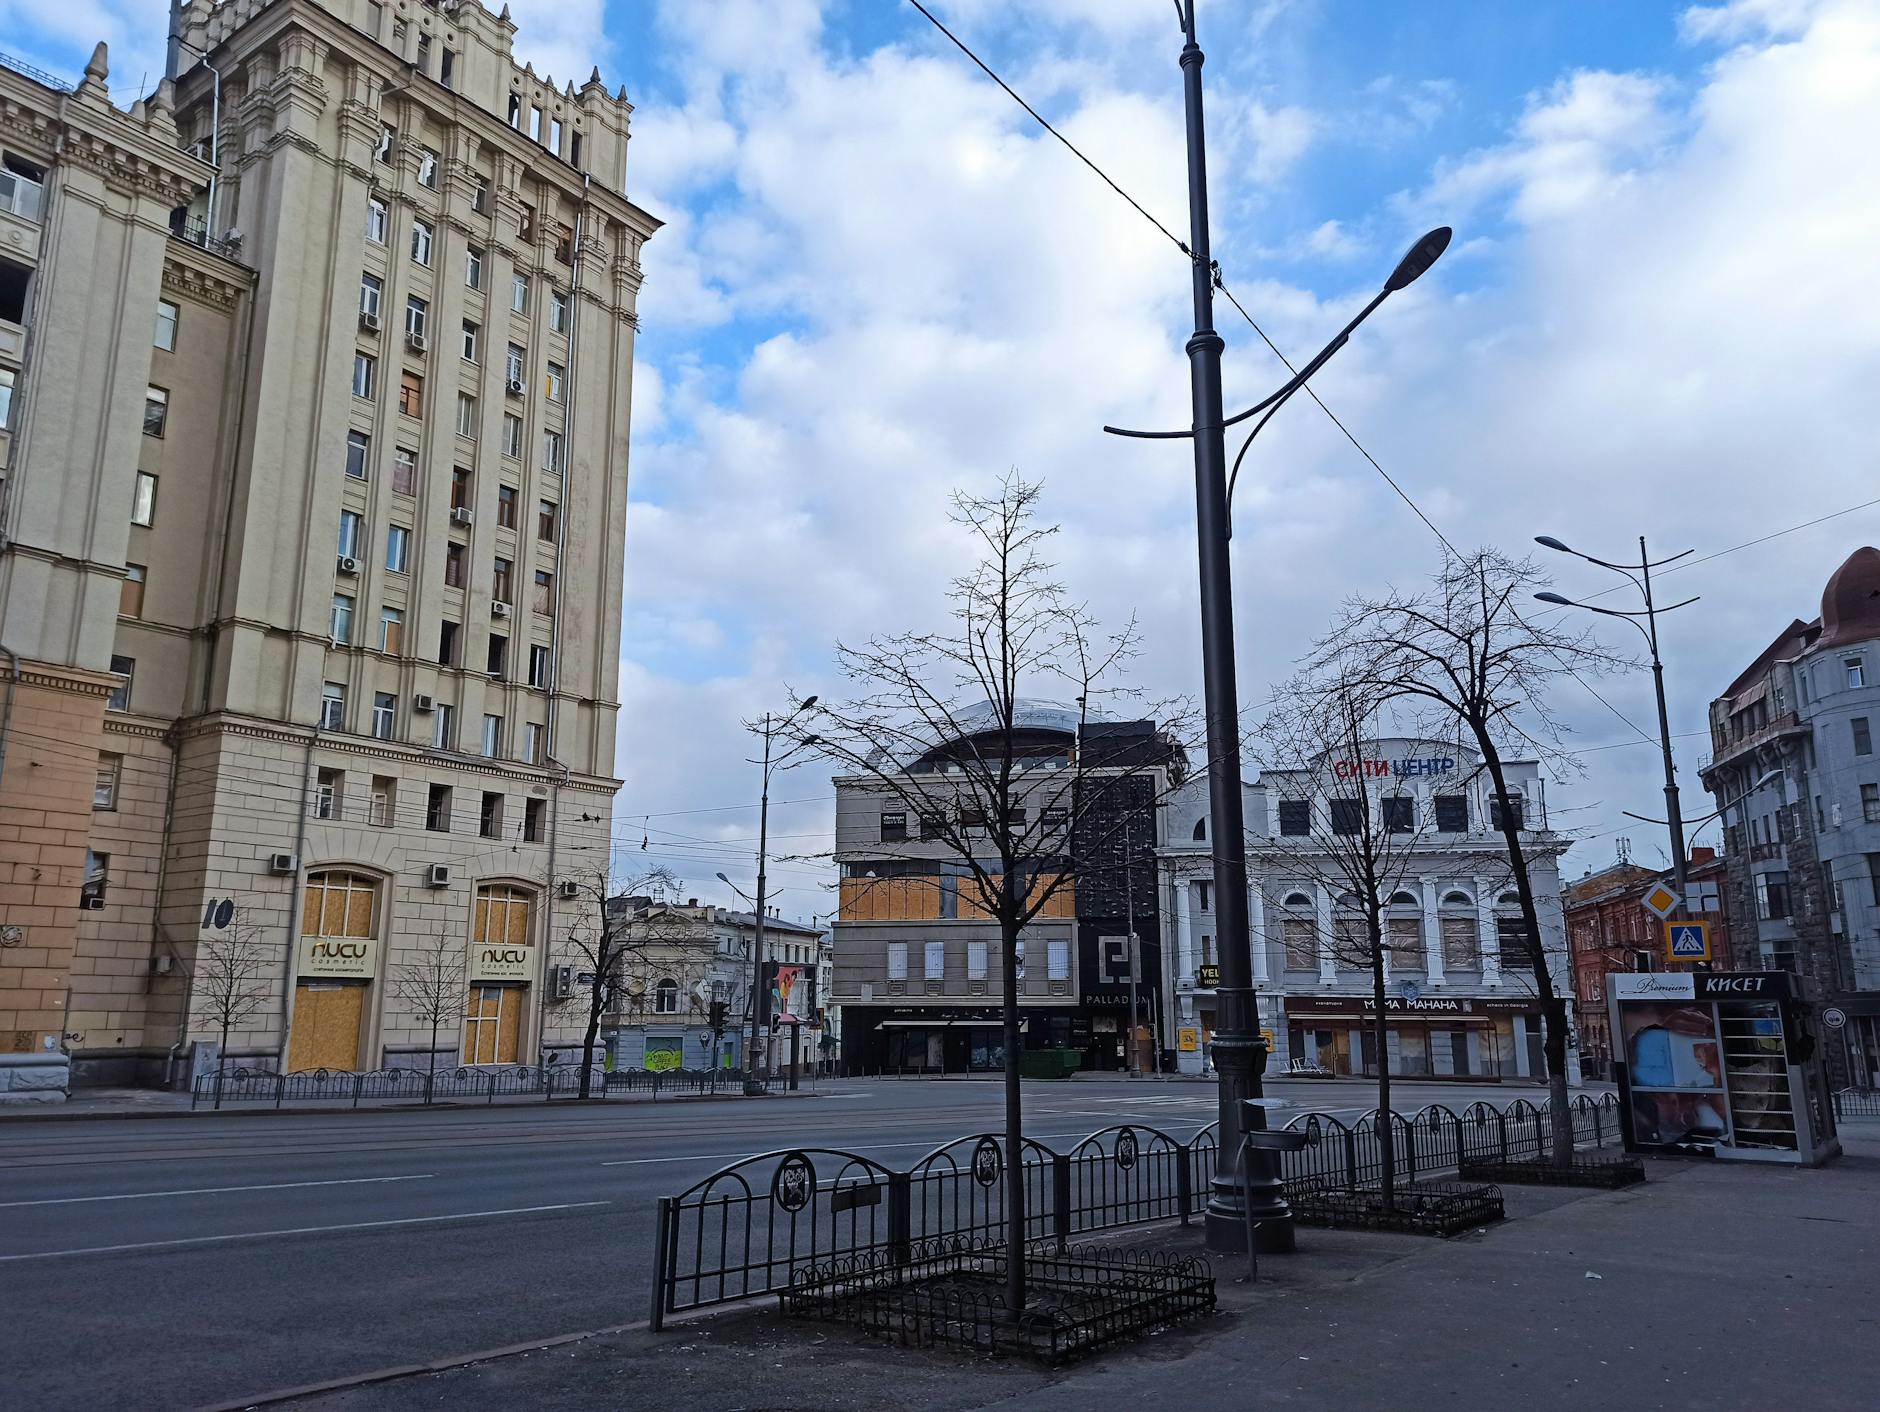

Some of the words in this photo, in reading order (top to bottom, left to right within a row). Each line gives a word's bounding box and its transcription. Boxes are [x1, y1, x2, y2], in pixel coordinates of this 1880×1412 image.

[1335, 760, 1389, 779] СИТИ
[1392, 758, 1454, 777] ЦЕНТР
[202, 900, 234, 929] 10
[1620, 977, 1693, 994] Premium
[1706, 977, 1766, 992] КИСЕТ
[1364, 1000, 1400, 1010] ММА
[1406, 1000, 1458, 1010] МАНАНА
